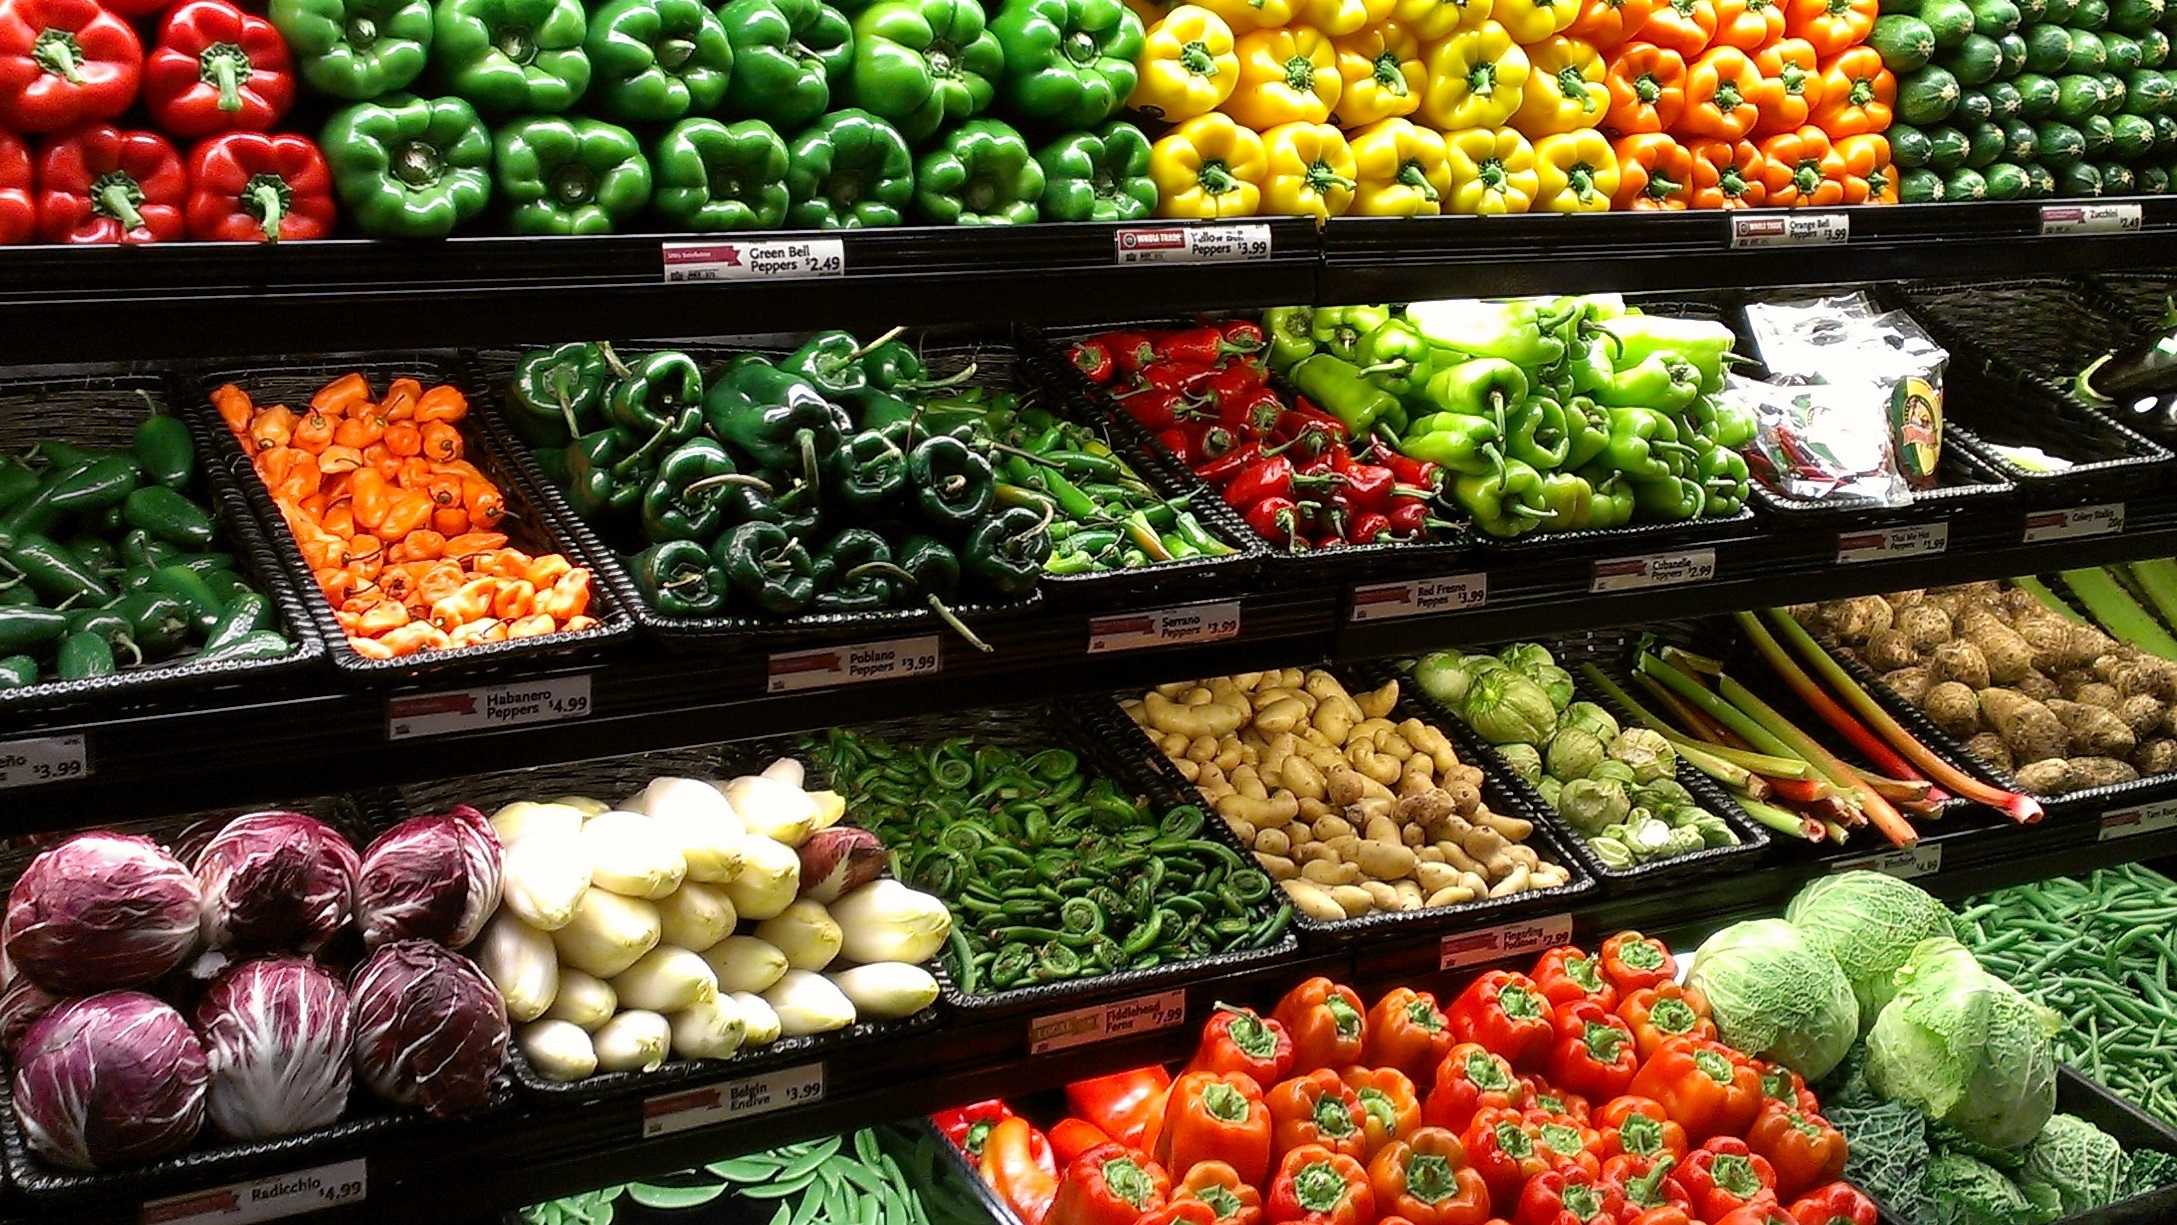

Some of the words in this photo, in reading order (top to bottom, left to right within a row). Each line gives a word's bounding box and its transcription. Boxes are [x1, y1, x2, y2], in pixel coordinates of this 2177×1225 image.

[2090, 208, 2119, 219] Zucchini
[1789, 221, 1815, 230] Orange
[1817, 218, 1831, 228] Bell
[1190, 232, 1223, 243] Yellow
[1789, 230, 1818, 240] Peppers
[1824, 228, 1847, 240] $3.99
[749, 247, 786, 260] Green
[788, 245, 811, 259] Bell
[1192, 244, 1231, 256] Peppers
[1237, 241, 1268, 255] $3.99
[750, 260, 798, 275] Peppers
[805, 257, 841, 272] $2.49
[1652, 558, 1692, 570] Cubanelle
[1688, 565, 1712, 578] $2.99
[1417, 587, 1434, 597] Red
[1437, 584, 1467, 595] Fresno
[1458, 589, 1485, 604] $3.99
[1161, 616, 1201, 628] Serrano
[1161, 627, 1201, 639] Peppers
[1207, 620, 1236, 634] $3.99
[850, 650, 896, 664] Poblano
[849, 662, 895, 677] Peppers
[902, 655, 936, 671] $3.99
[487, 690, 552, 706] Habanero
[487, 704, 540, 720] Peppers
[548, 696, 588, 713] $4.99
[33, 760, 81, 779] $3.99
[1503, 927, 1543, 942] Fingerling
[1503, 937, 1538, 951] Potatoes
[1105, 1000, 1161, 1023] Fiddlehead
[1105, 1020, 1134, 1033] Ferns
[1152, 1008, 1182, 1025] $7.99
[730, 1095, 770, 1111] Endive
[786, 1082, 821, 1101] $3.99
[251, 1176, 321, 1201] Radicchio
[319, 1180, 362, 1201] $4.99
